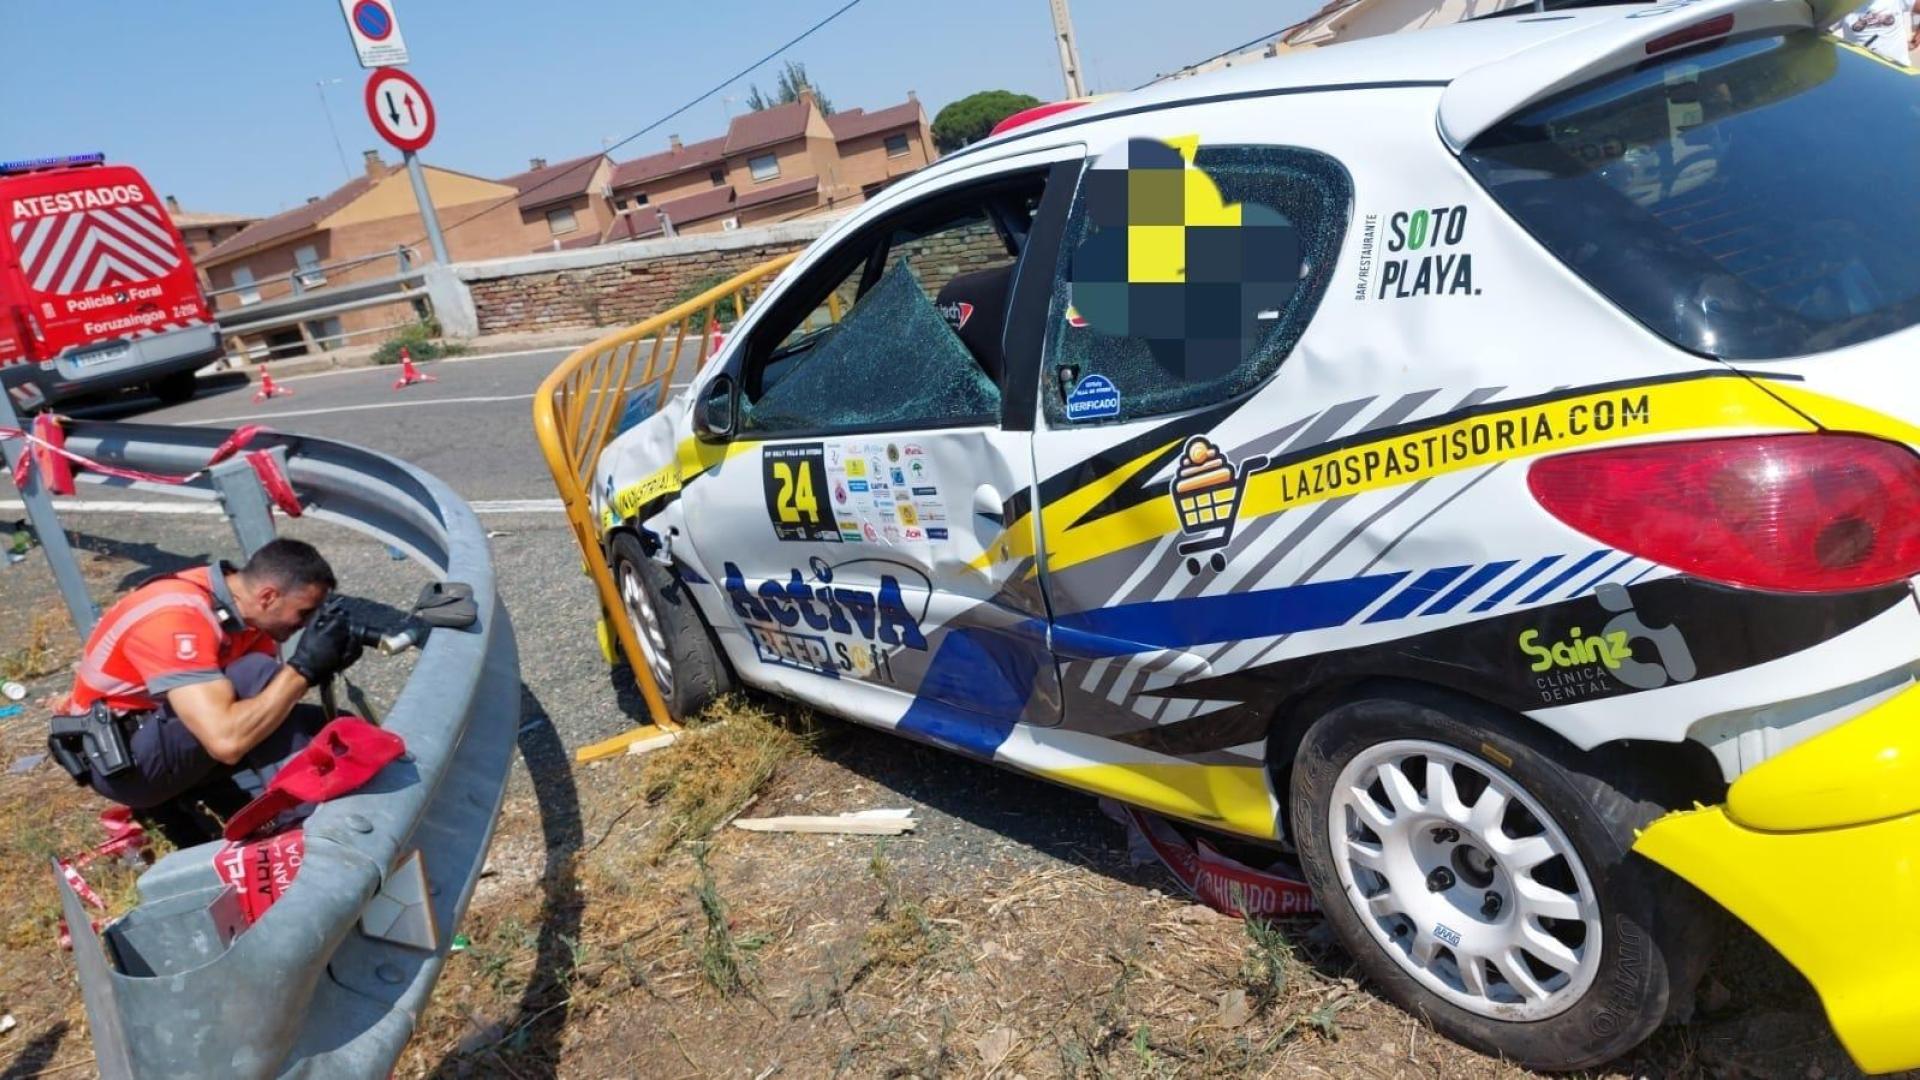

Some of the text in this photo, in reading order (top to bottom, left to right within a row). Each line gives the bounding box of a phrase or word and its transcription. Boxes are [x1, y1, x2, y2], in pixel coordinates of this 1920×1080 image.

[12, 185, 144, 218] ATESTADOS
[1388, 205, 1467, 252] SOTO
[1355, 214, 1377, 300] BAR/RESTAURANTE
[1378, 254, 1482, 300] PLAYA.
[129, 284, 163, 301] Foral
[1070, 398, 1117, 413] VERIFICADO
[1280, 394, 1651, 503] LAZOSPASTISORIA.COM
[773, 460, 820, 523] 24
[1519, 626, 1633, 672] Sainz
[1541, 680, 1611, 703] DENTAL
